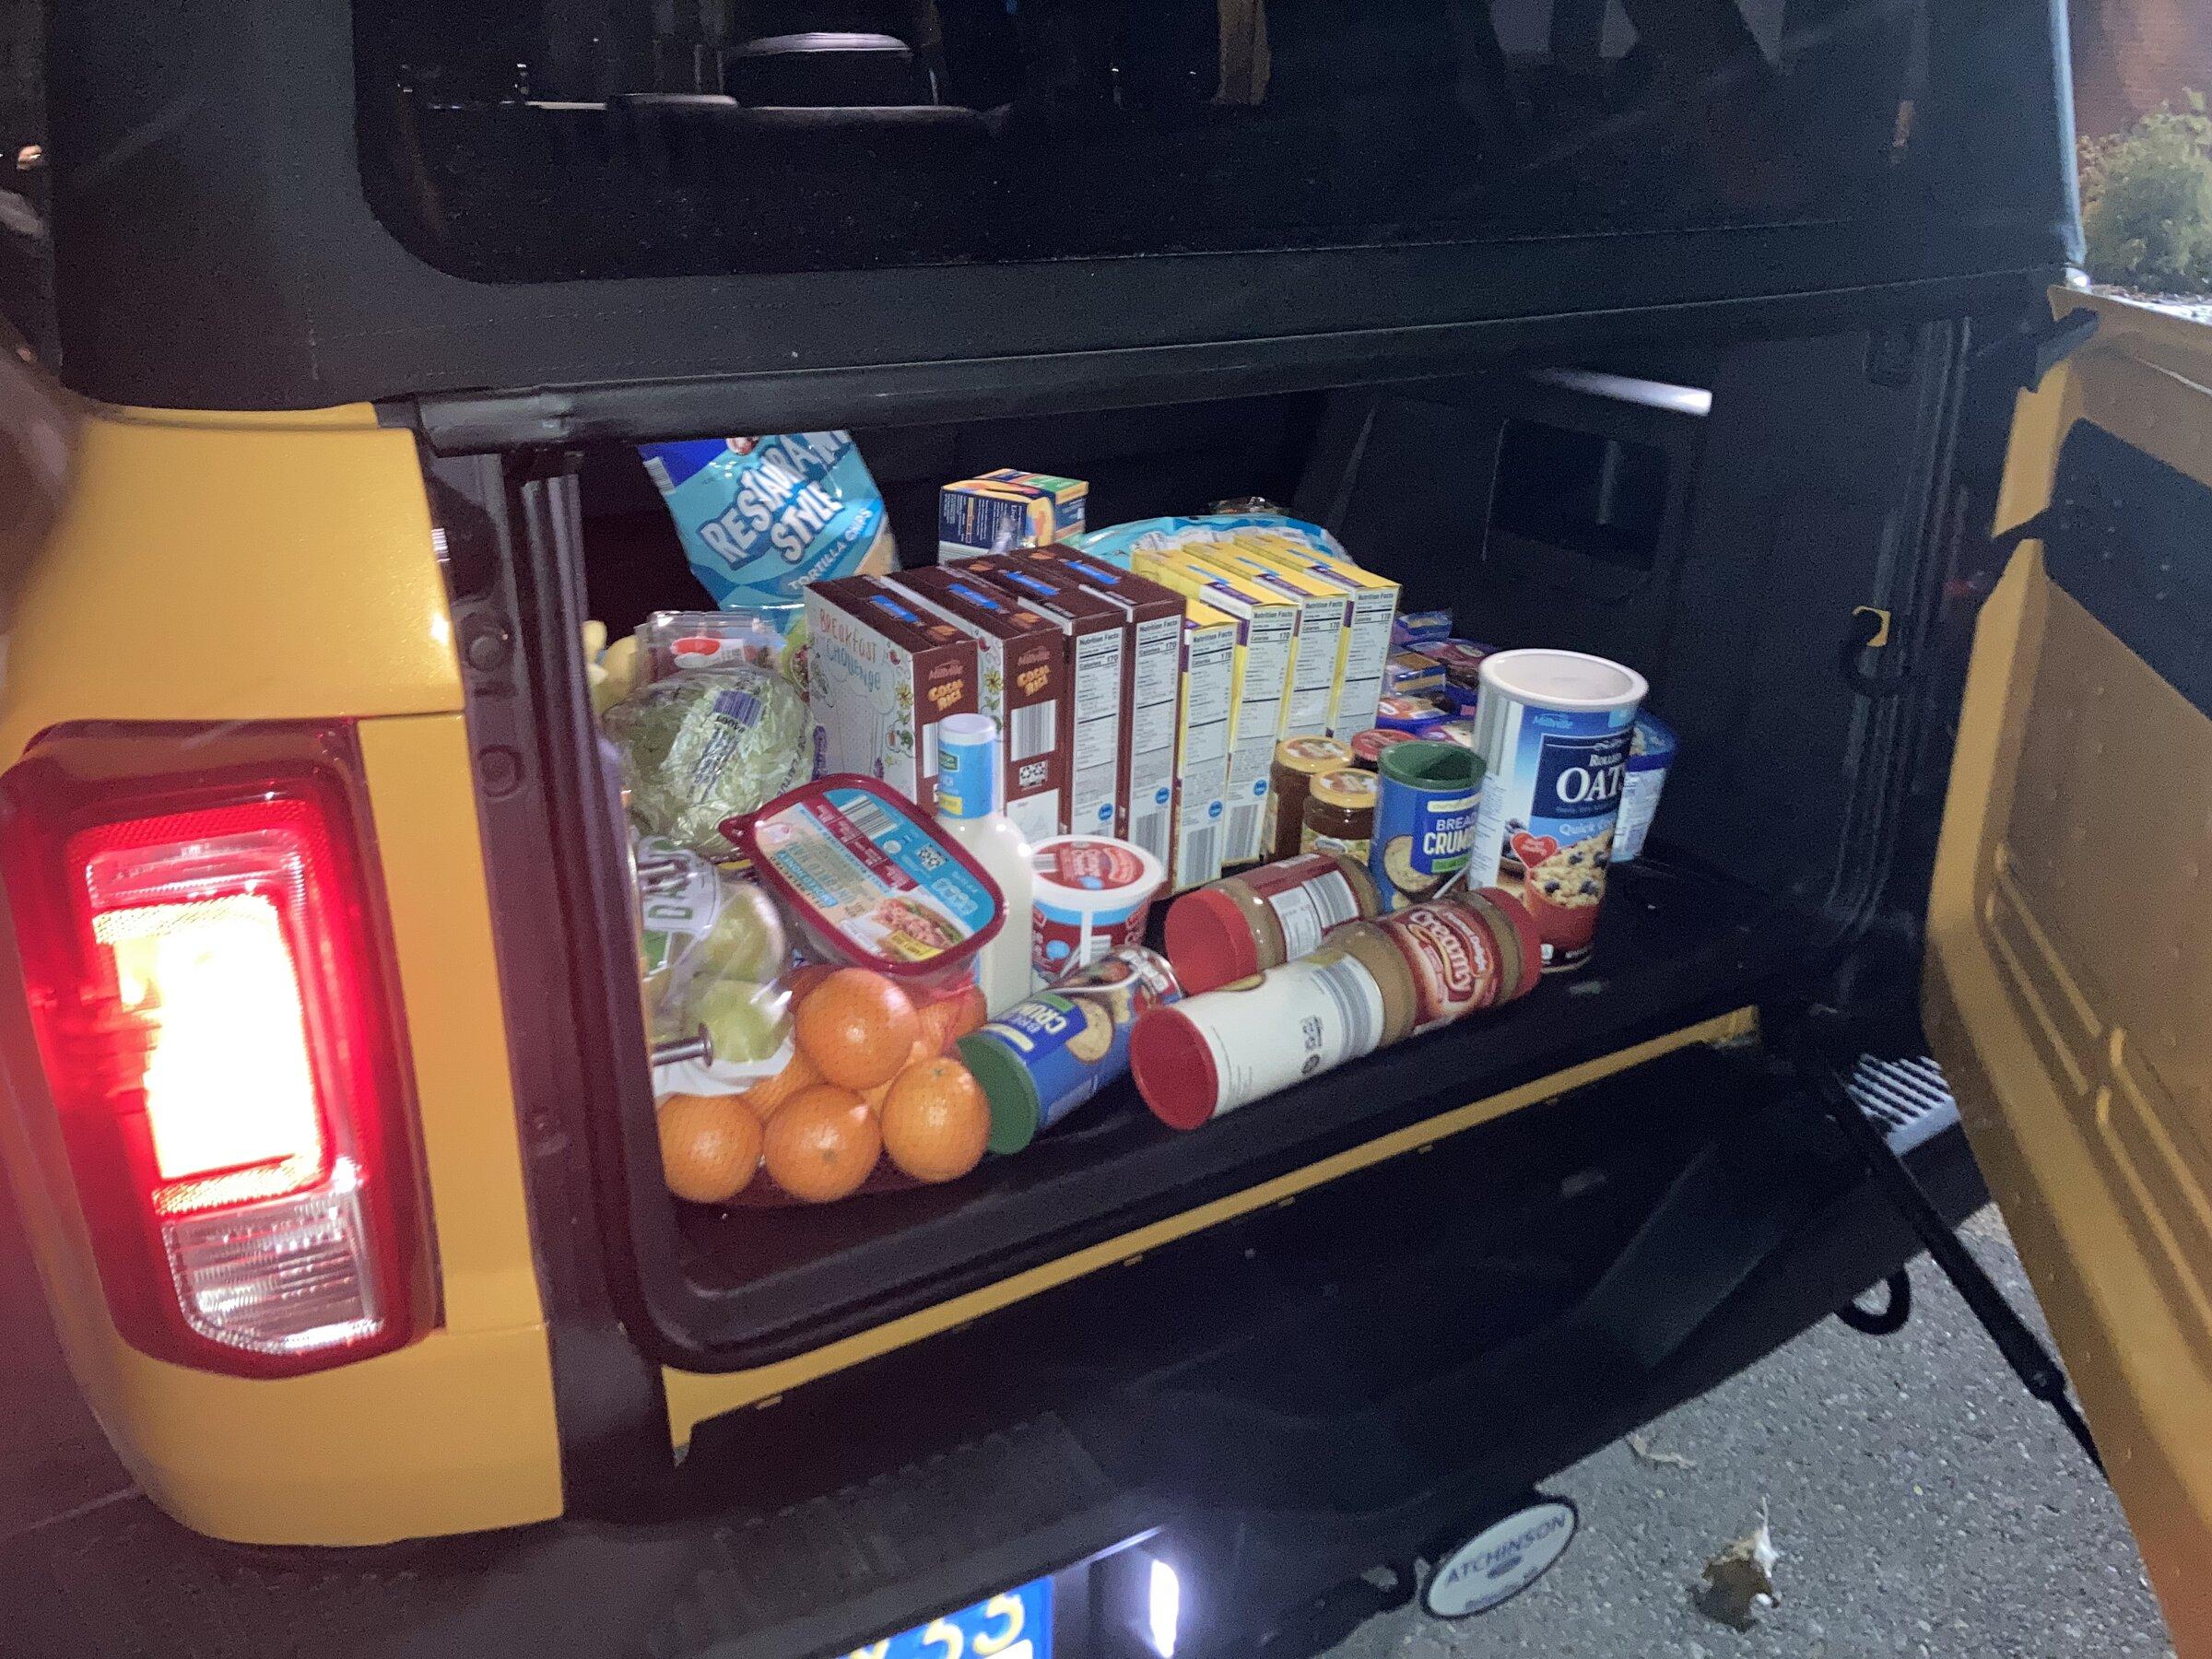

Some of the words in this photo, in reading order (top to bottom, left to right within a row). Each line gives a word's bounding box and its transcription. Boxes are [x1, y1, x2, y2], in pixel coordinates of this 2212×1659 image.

[771, 481, 844, 561] STYLE
[787, 541, 847, 591] TORTILLA
[844, 507, 874, 542] CHIPS
[1079, 635, 1104, 645] Nutrition
[1104, 632, 1119, 642] Facts
[1139, 622, 1163, 632] Nutrition
[1163, 619, 1178, 629] Facts
[1556, 763, 1626, 803] OAT
[1410, 912, 1473, 993] Creamy
